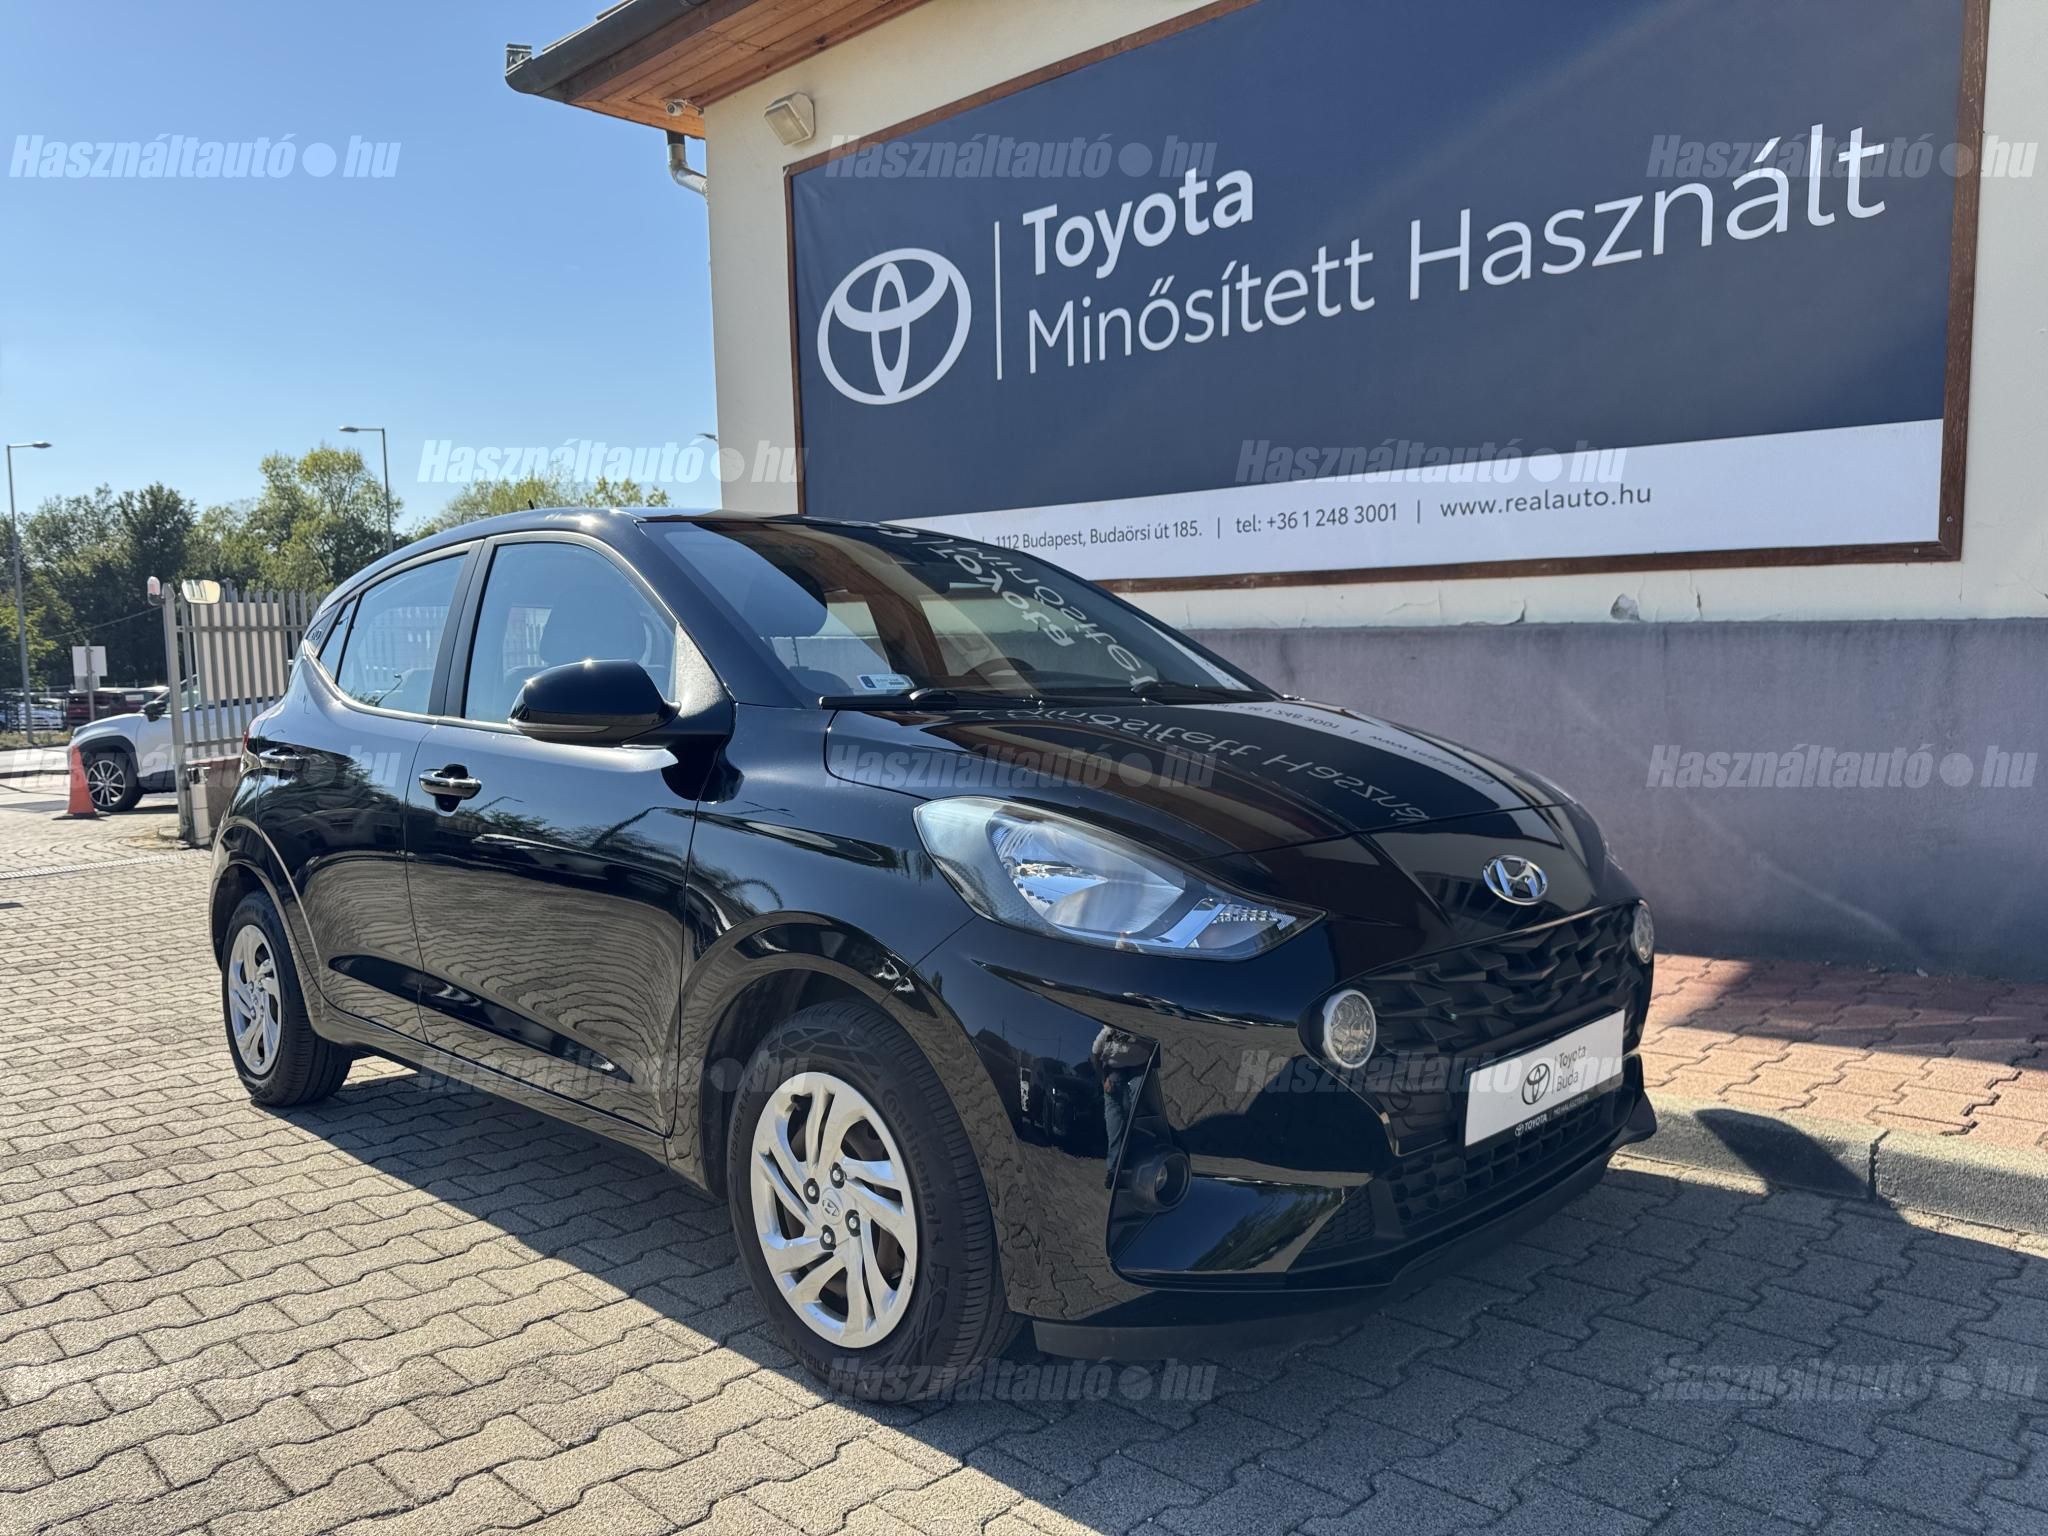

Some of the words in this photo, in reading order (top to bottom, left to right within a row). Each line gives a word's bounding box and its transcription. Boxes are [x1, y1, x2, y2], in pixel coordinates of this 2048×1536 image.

[1022, 167, 1253, 279] Toyota
[1028, 238, 1375, 375] Minősített
[1409, 123, 1886, 301] Használt
[1022, 532, 1087, 551] Budapest,
[1090, 523, 1151, 544] Budaörsi
[1154, 519, 1170, 539] út
[1173, 519, 1203, 539] 185.
[1236, 514, 1262, 533] tel:
[1267, 511, 1298, 531] +36
[1303, 510, 1310, 528] 1
[1316, 507, 1349, 528] 248
[1354, 502, 1398, 524] 3001
[1440, 482, 1652, 518] www.realauto.hu
[1556, 1068, 1579, 1091] Buda
[1559, 1045, 1586, 1068] Toyota
[881, 1088, 943, 1225] Continental
[1525, 1113, 1548, 1131] TOYOTA
